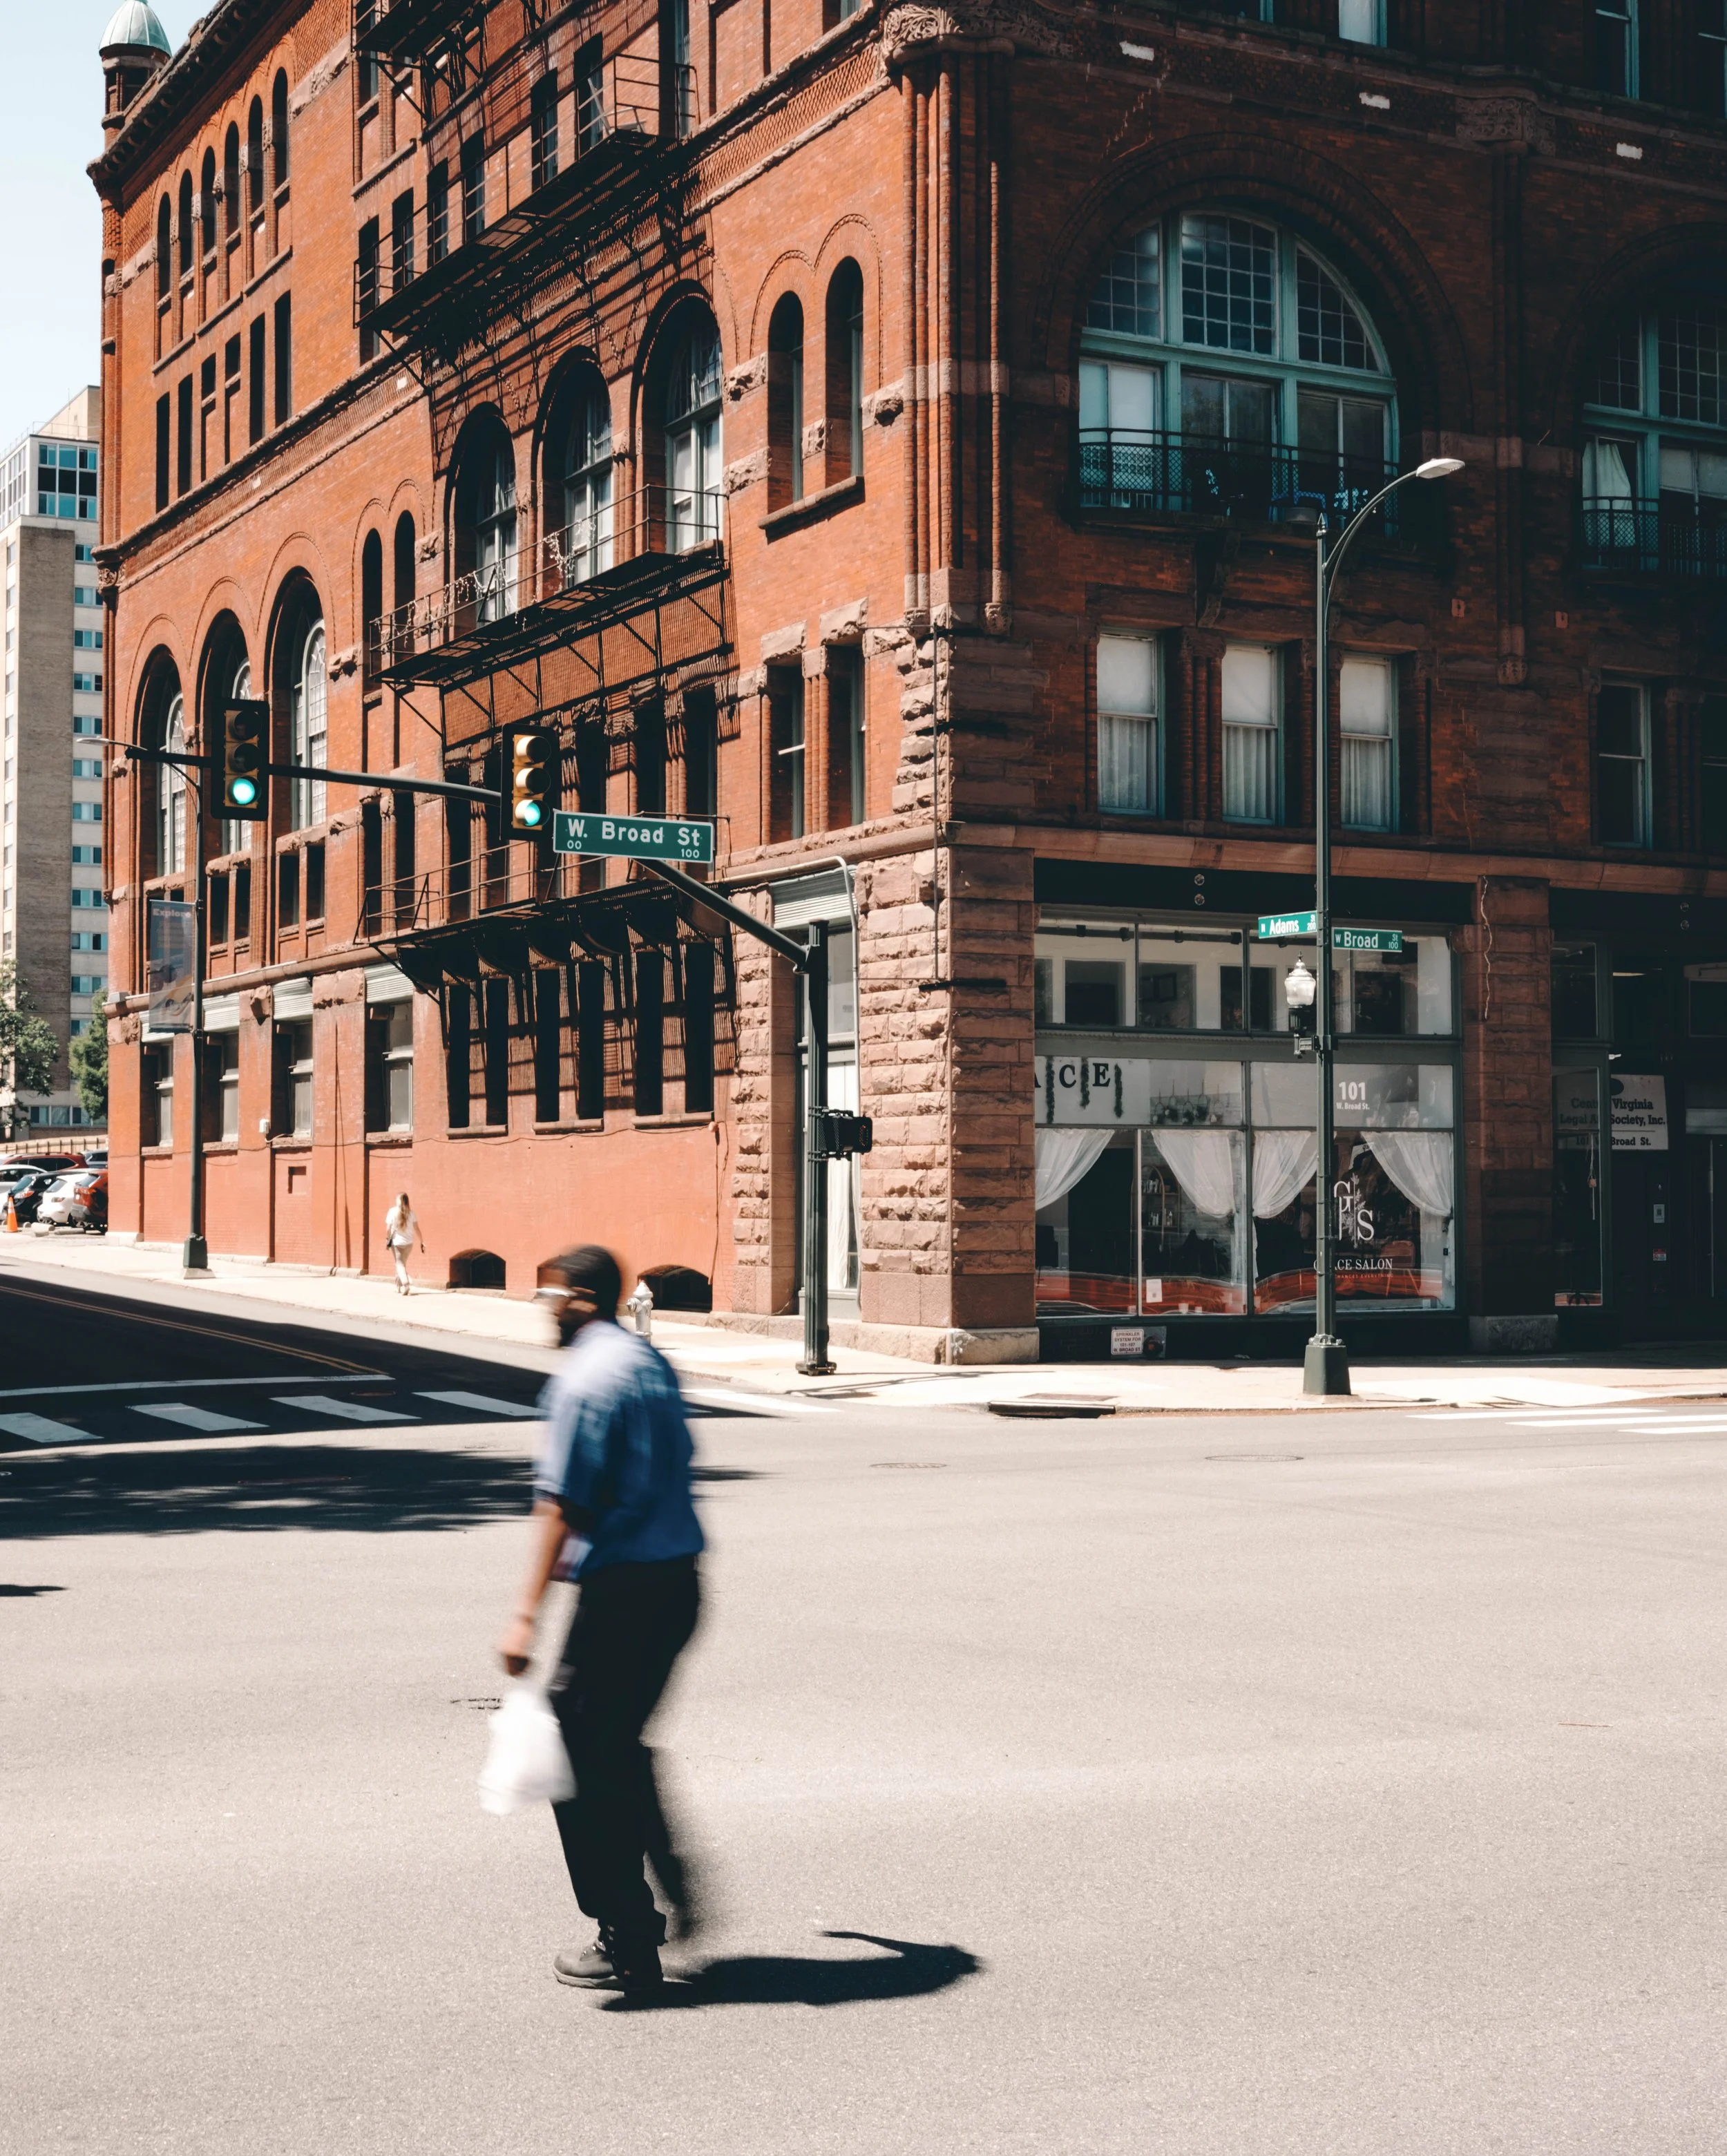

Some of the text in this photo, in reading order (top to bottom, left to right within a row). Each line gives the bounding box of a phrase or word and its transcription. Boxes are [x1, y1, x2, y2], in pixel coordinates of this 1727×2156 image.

[567, 818, 700, 847] W. Broad St
[567, 840, 582, 850] 00
[680, 848, 700, 859] 100
[153, 908, 191, 919] Explore
[1261, 914, 1315, 935] N Adams St
[1335, 931, 1398, 948] W Broad St
[1339, 1081, 1366, 1100] 101
[1344, 1102, 1361, 1110] Broad
[1362, 1102, 1370, 1110] St.
[1612, 1098, 1654, 1112] Virginia
[1559, 1114, 1587, 1125] Legal
[1610, 1114, 1645, 1127] Society,
[1648, 1115, 1666, 1125] Inc.
[1612, 1137, 1636, 1145] Broad
[1640, 1137, 1652, 1146] St.
[1355, 1259, 1393, 1270] SALON
